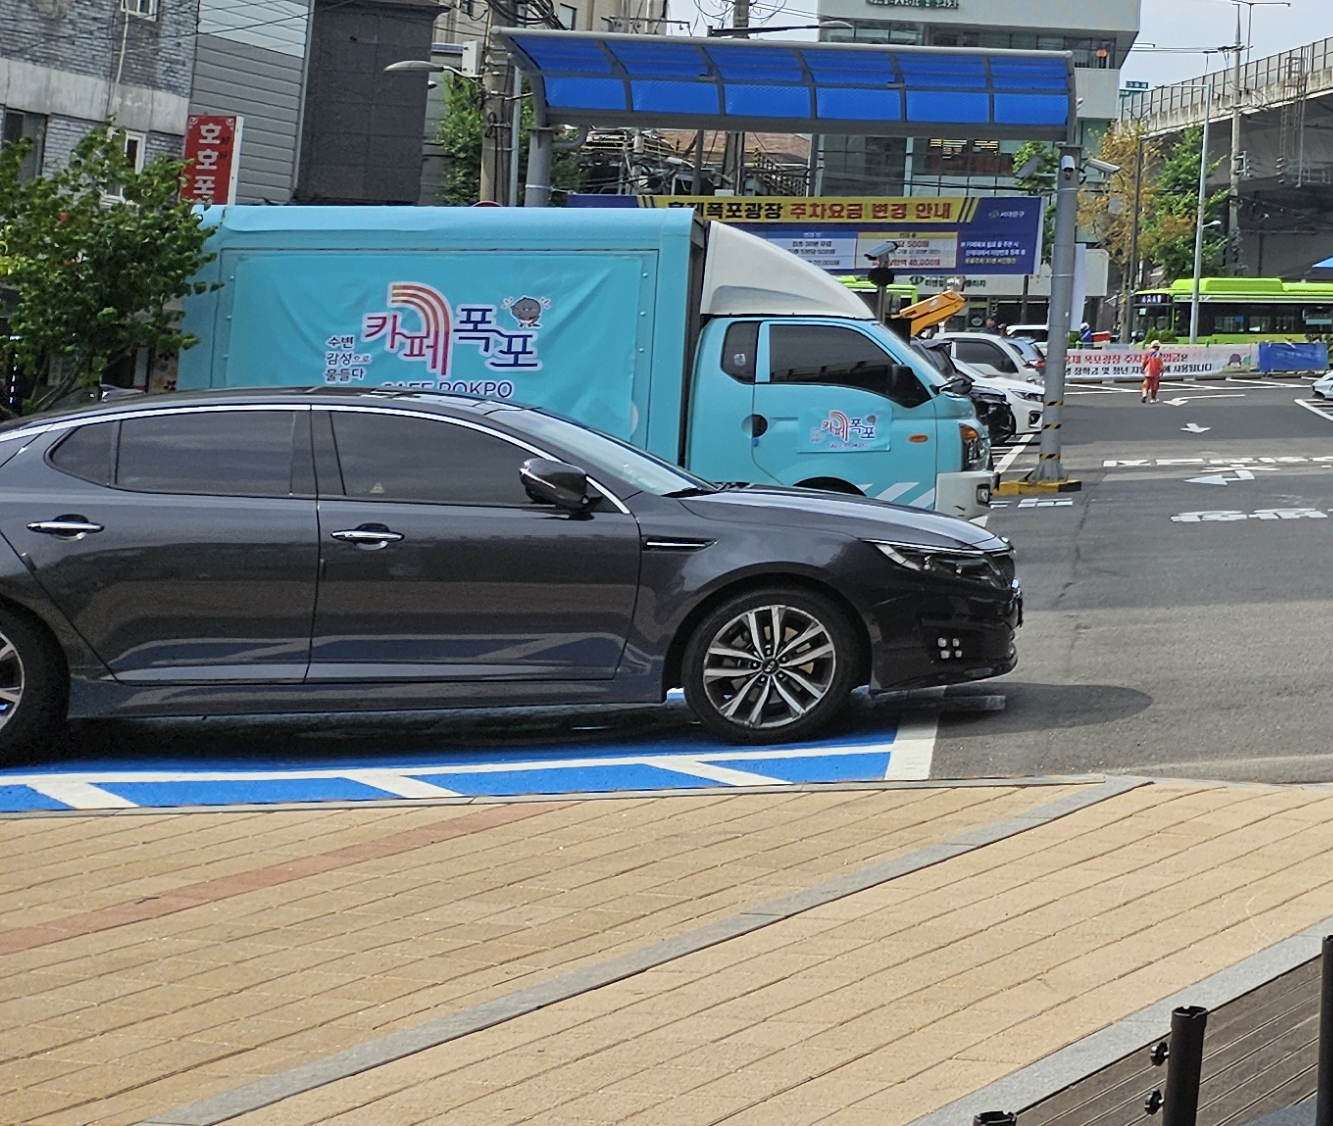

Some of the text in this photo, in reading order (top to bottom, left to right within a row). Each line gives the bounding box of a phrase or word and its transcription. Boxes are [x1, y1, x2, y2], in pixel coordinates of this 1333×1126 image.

[193, 123, 222, 205] 호호포
[790, 202, 863, 220] 주차요금
[871, 202, 907, 220] 변경
[915, 202, 953, 220] 안내
[327, 336, 354, 349] 수변
[326, 353, 370, 367] 감성으로
[1173, 362, 1213, 373] 사용됩니다
[326, 368, 365, 382] 물들다
